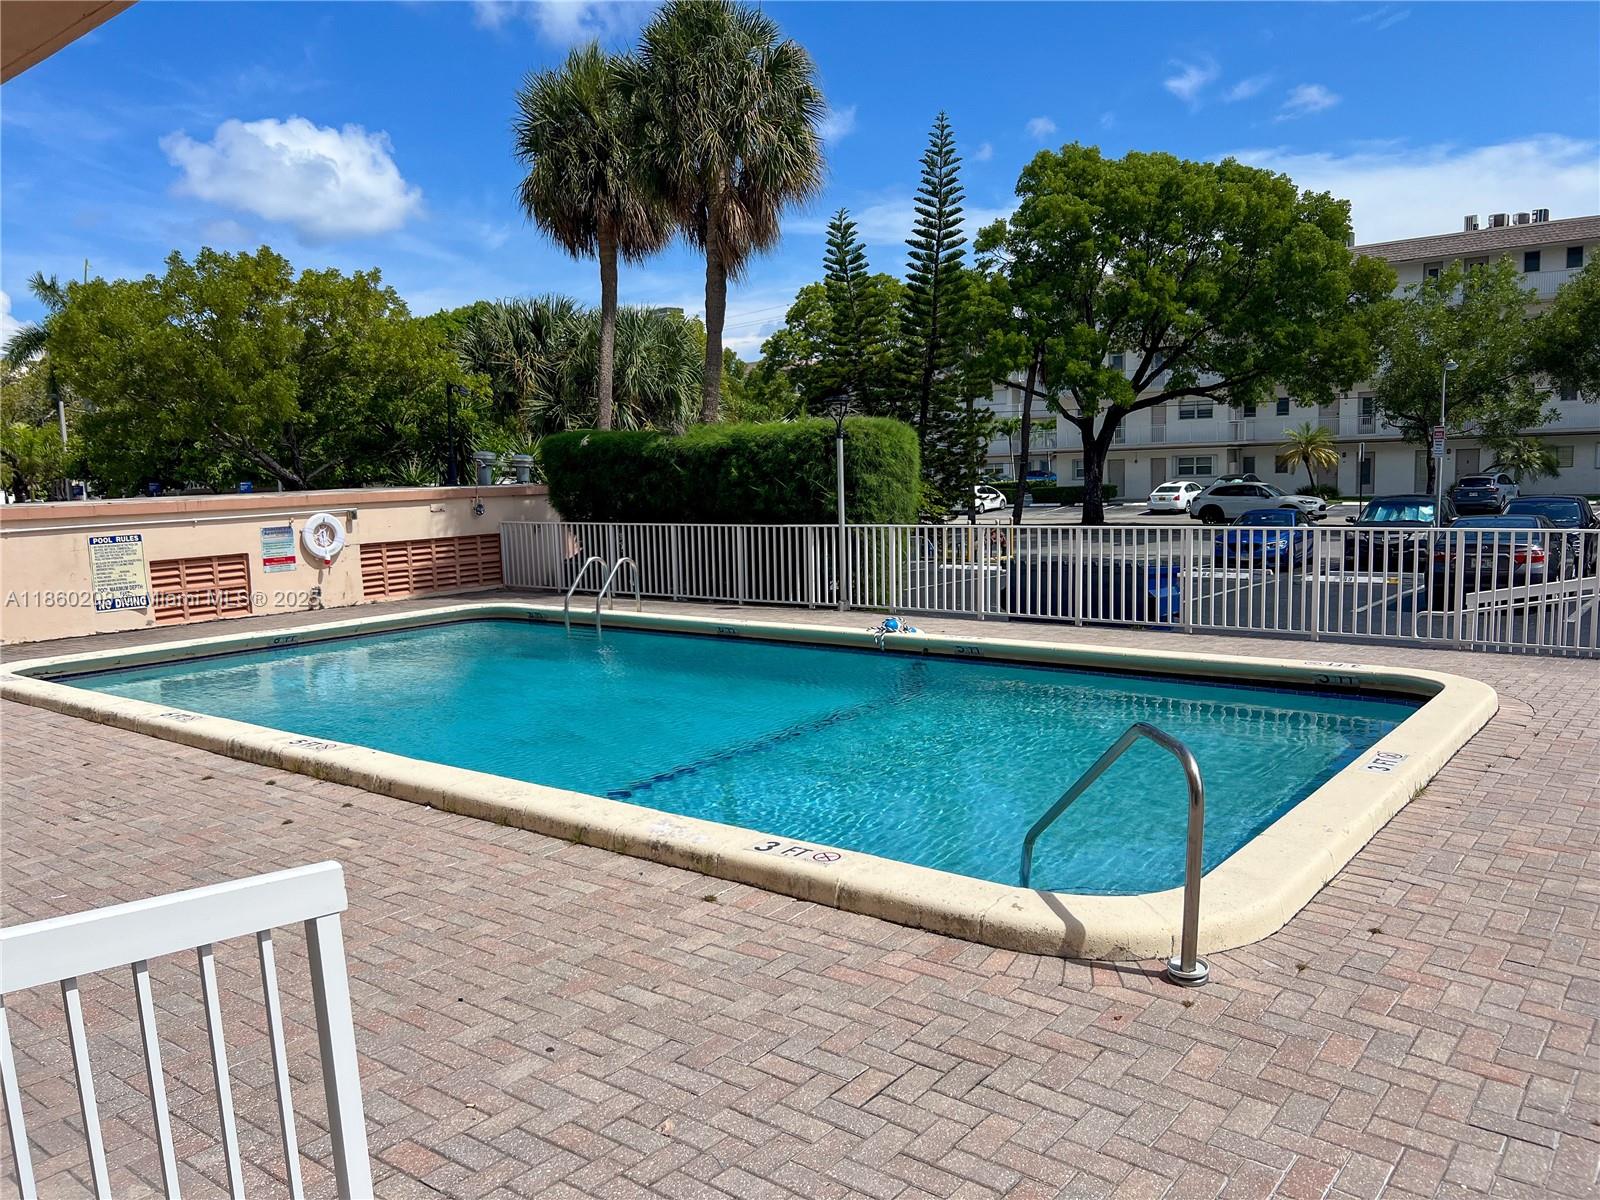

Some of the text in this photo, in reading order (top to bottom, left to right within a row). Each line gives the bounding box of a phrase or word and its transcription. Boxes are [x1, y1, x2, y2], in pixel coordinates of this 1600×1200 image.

[98, 596, 147, 610] NO DIVING
[754, 841, 814, 857] 3 FT
